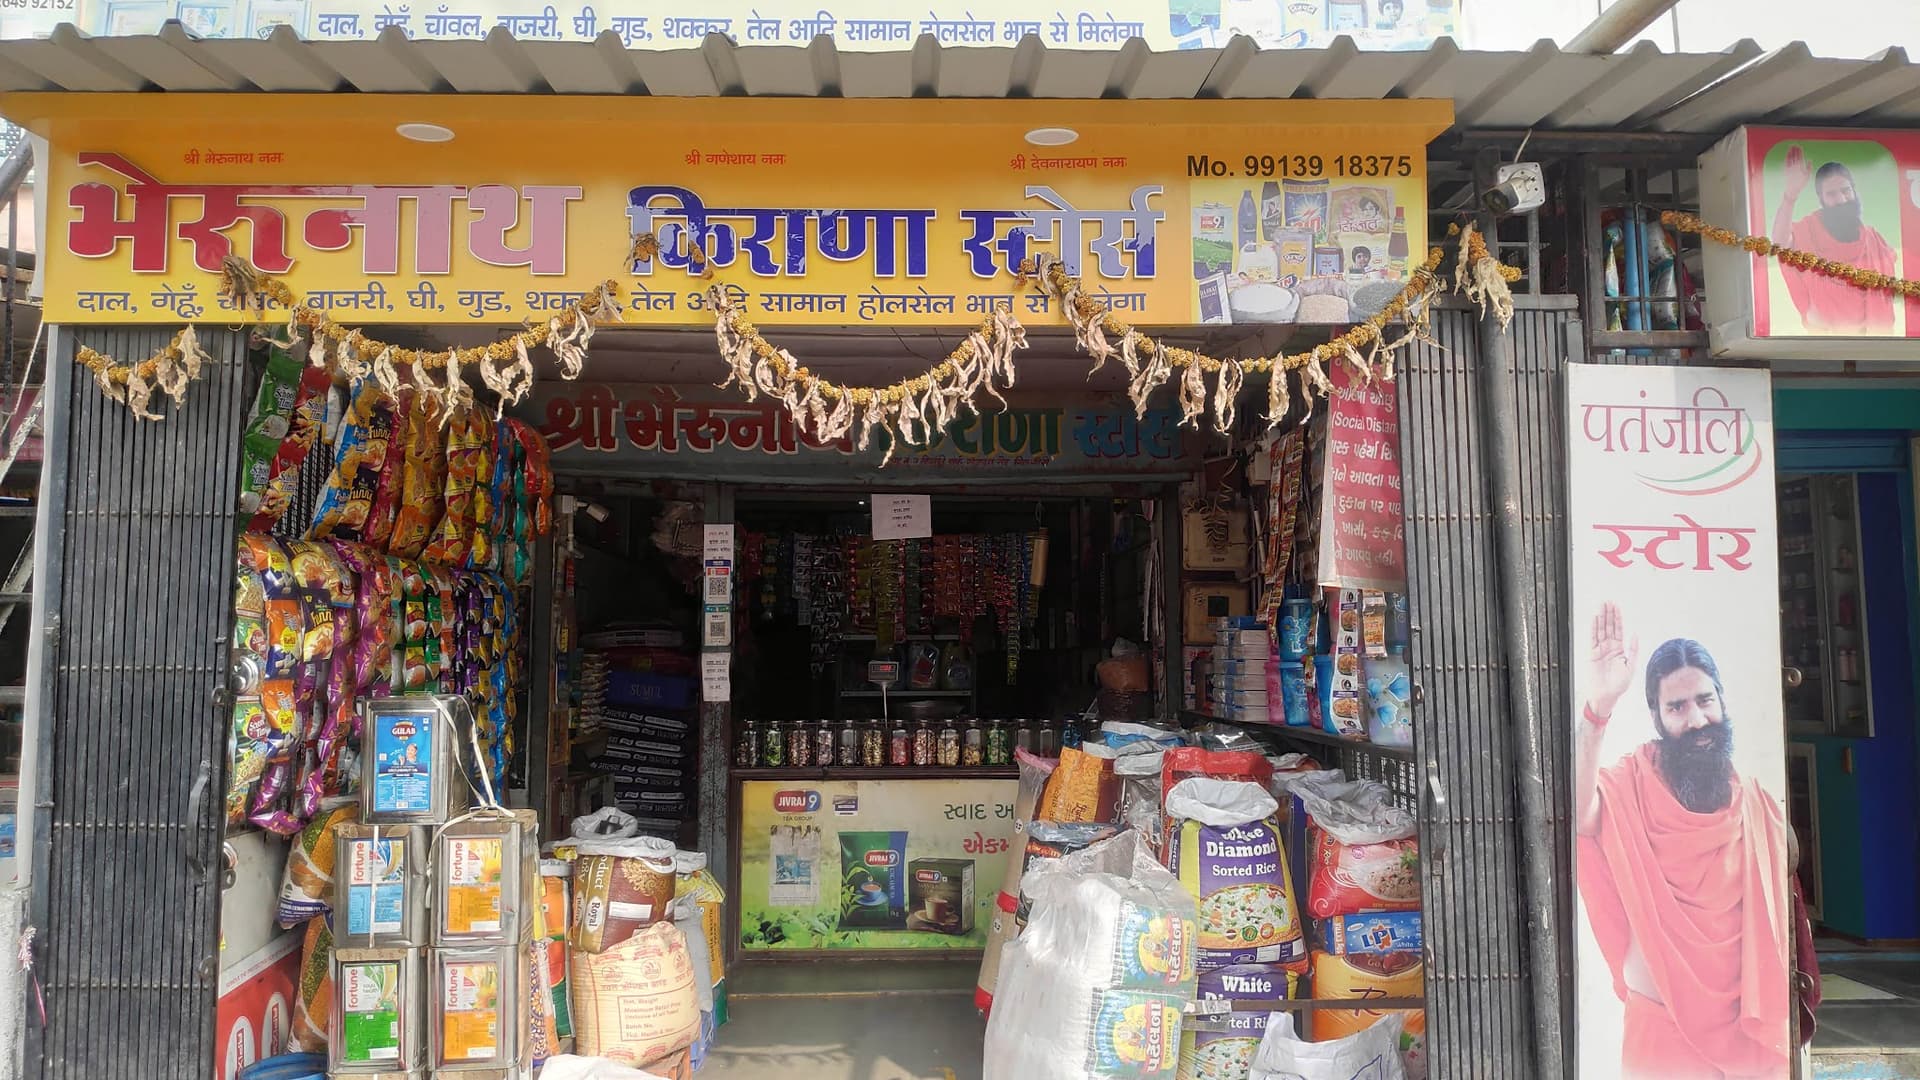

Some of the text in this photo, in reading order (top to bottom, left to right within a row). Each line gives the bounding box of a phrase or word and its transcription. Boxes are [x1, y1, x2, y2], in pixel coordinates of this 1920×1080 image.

[319, 13, 364, 36] दाल,
[747, 9, 782, 40] तेल
[844, 20, 911, 41] सामान
[1050, 11, 1069, 42] से
[706, 151, 756, 165] गणेशाय
[1187, 155, 1412, 177] Mo. 99139 18375
[626, 185, 936, 278] किराणा
[960, 185, 1166, 278] स्टोर्स
[78, 290, 137, 314] दाल,
[150, 283, 204, 318] गेहूँ,
[307, 281, 394, 312] बाजरी,
[407, 281, 444, 312] घी,
[457, 291, 511, 317] गुड,
[631, 282, 676, 311] तेल
[760, 293, 847, 313] सामान
[858, 285, 955, 320] होलसेल
[1026, 286, 1049, 313] से
[1332, 411, 1364, 431] (Social
[1581, 387, 1745, 455] पतंजलि
[1349, 472, 1383, 488] આવતા
[1593, 514, 1756, 571] स्टोर
[778, 794, 818, 809] JIVRAJ 9
[944, 803, 987, 820] સ્વાદ
[889, 854, 896, 862] 9
[1206, 837, 1277, 857] Diamond
[354, 842, 364, 881] fortune
[452, 842, 463, 881] fortune
[1212, 862, 1277, 877] Sorted Rice
[588, 902, 601, 927] Royal
[1361, 926, 1402, 949] LPL
[349, 969, 358, 1008] fortune
[448, 968, 458, 1008] fortune
[1222, 975, 1272, 993] White
